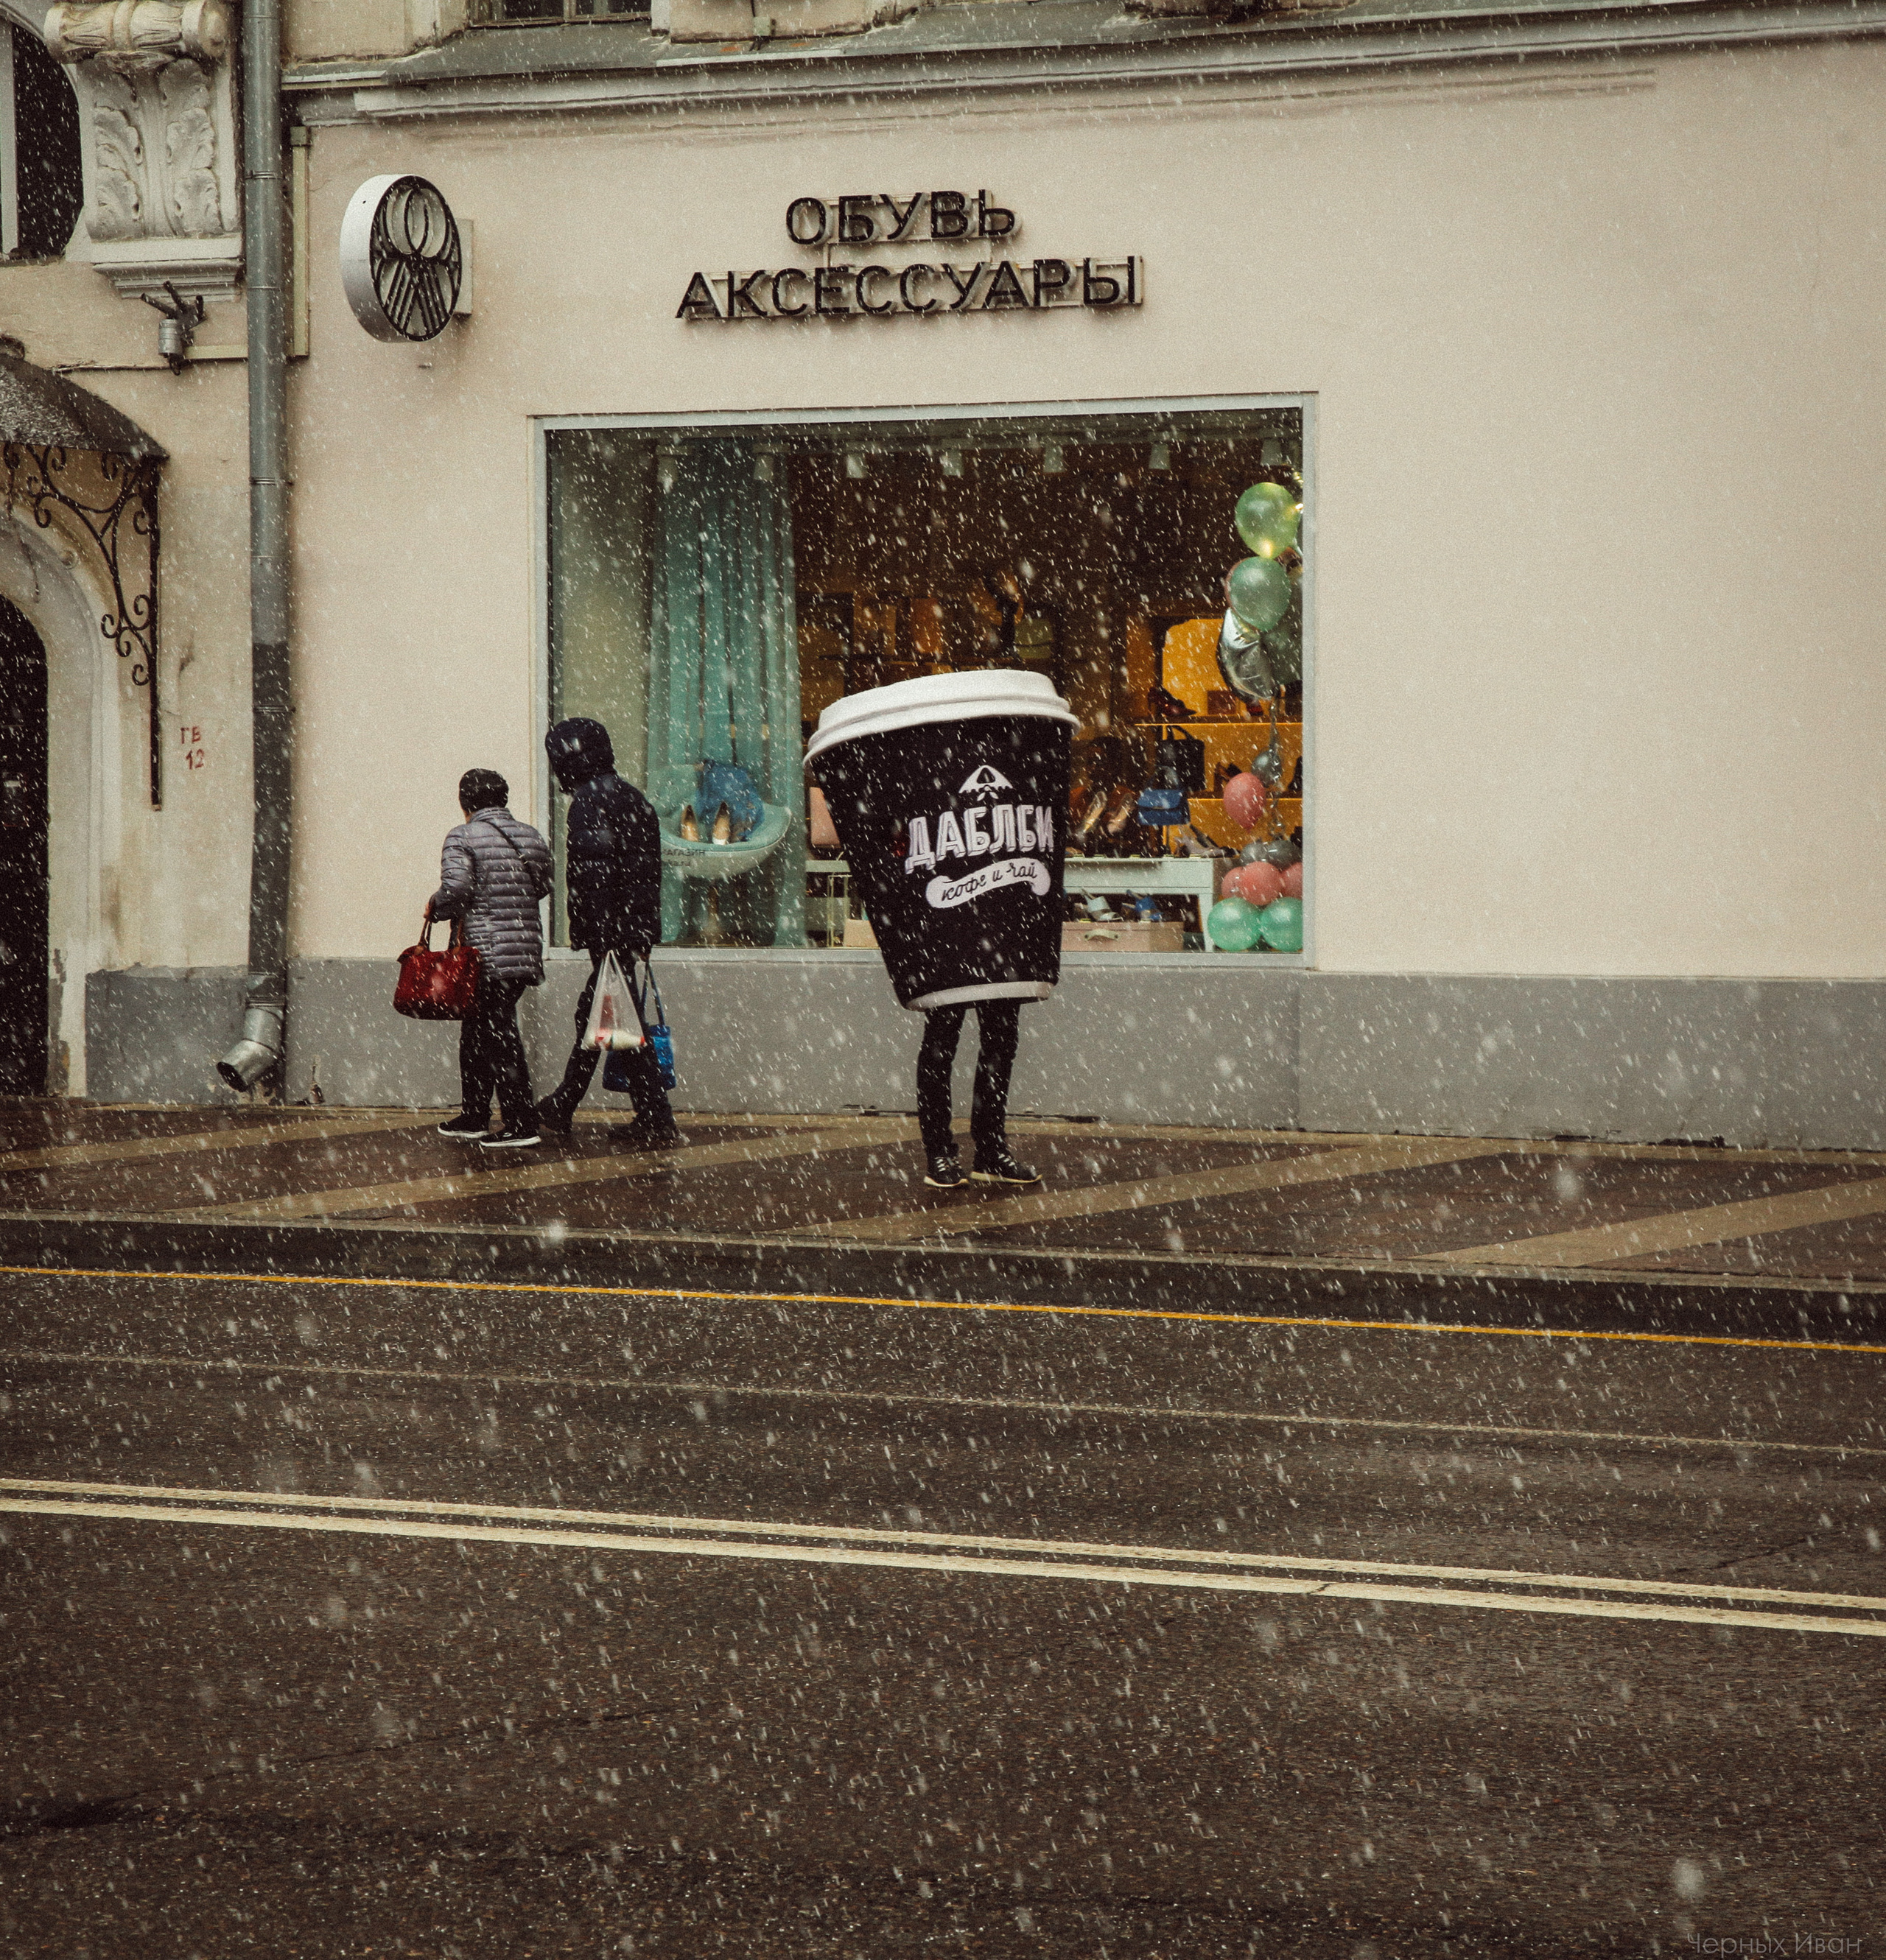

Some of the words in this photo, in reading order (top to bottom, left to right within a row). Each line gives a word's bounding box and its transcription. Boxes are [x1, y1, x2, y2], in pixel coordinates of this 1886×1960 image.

[785, 189, 1020, 245] ОБУВЬ
[676, 256, 1142, 319] АКСЕССУАРЫ
[186, 748, 204, 770] 12
[905, 804, 1054, 874] ДАБЛБИ
[942, 875, 987, 901] кофе
[992, 869, 1003, 882] и
[1006, 862, 1037, 879] чай
